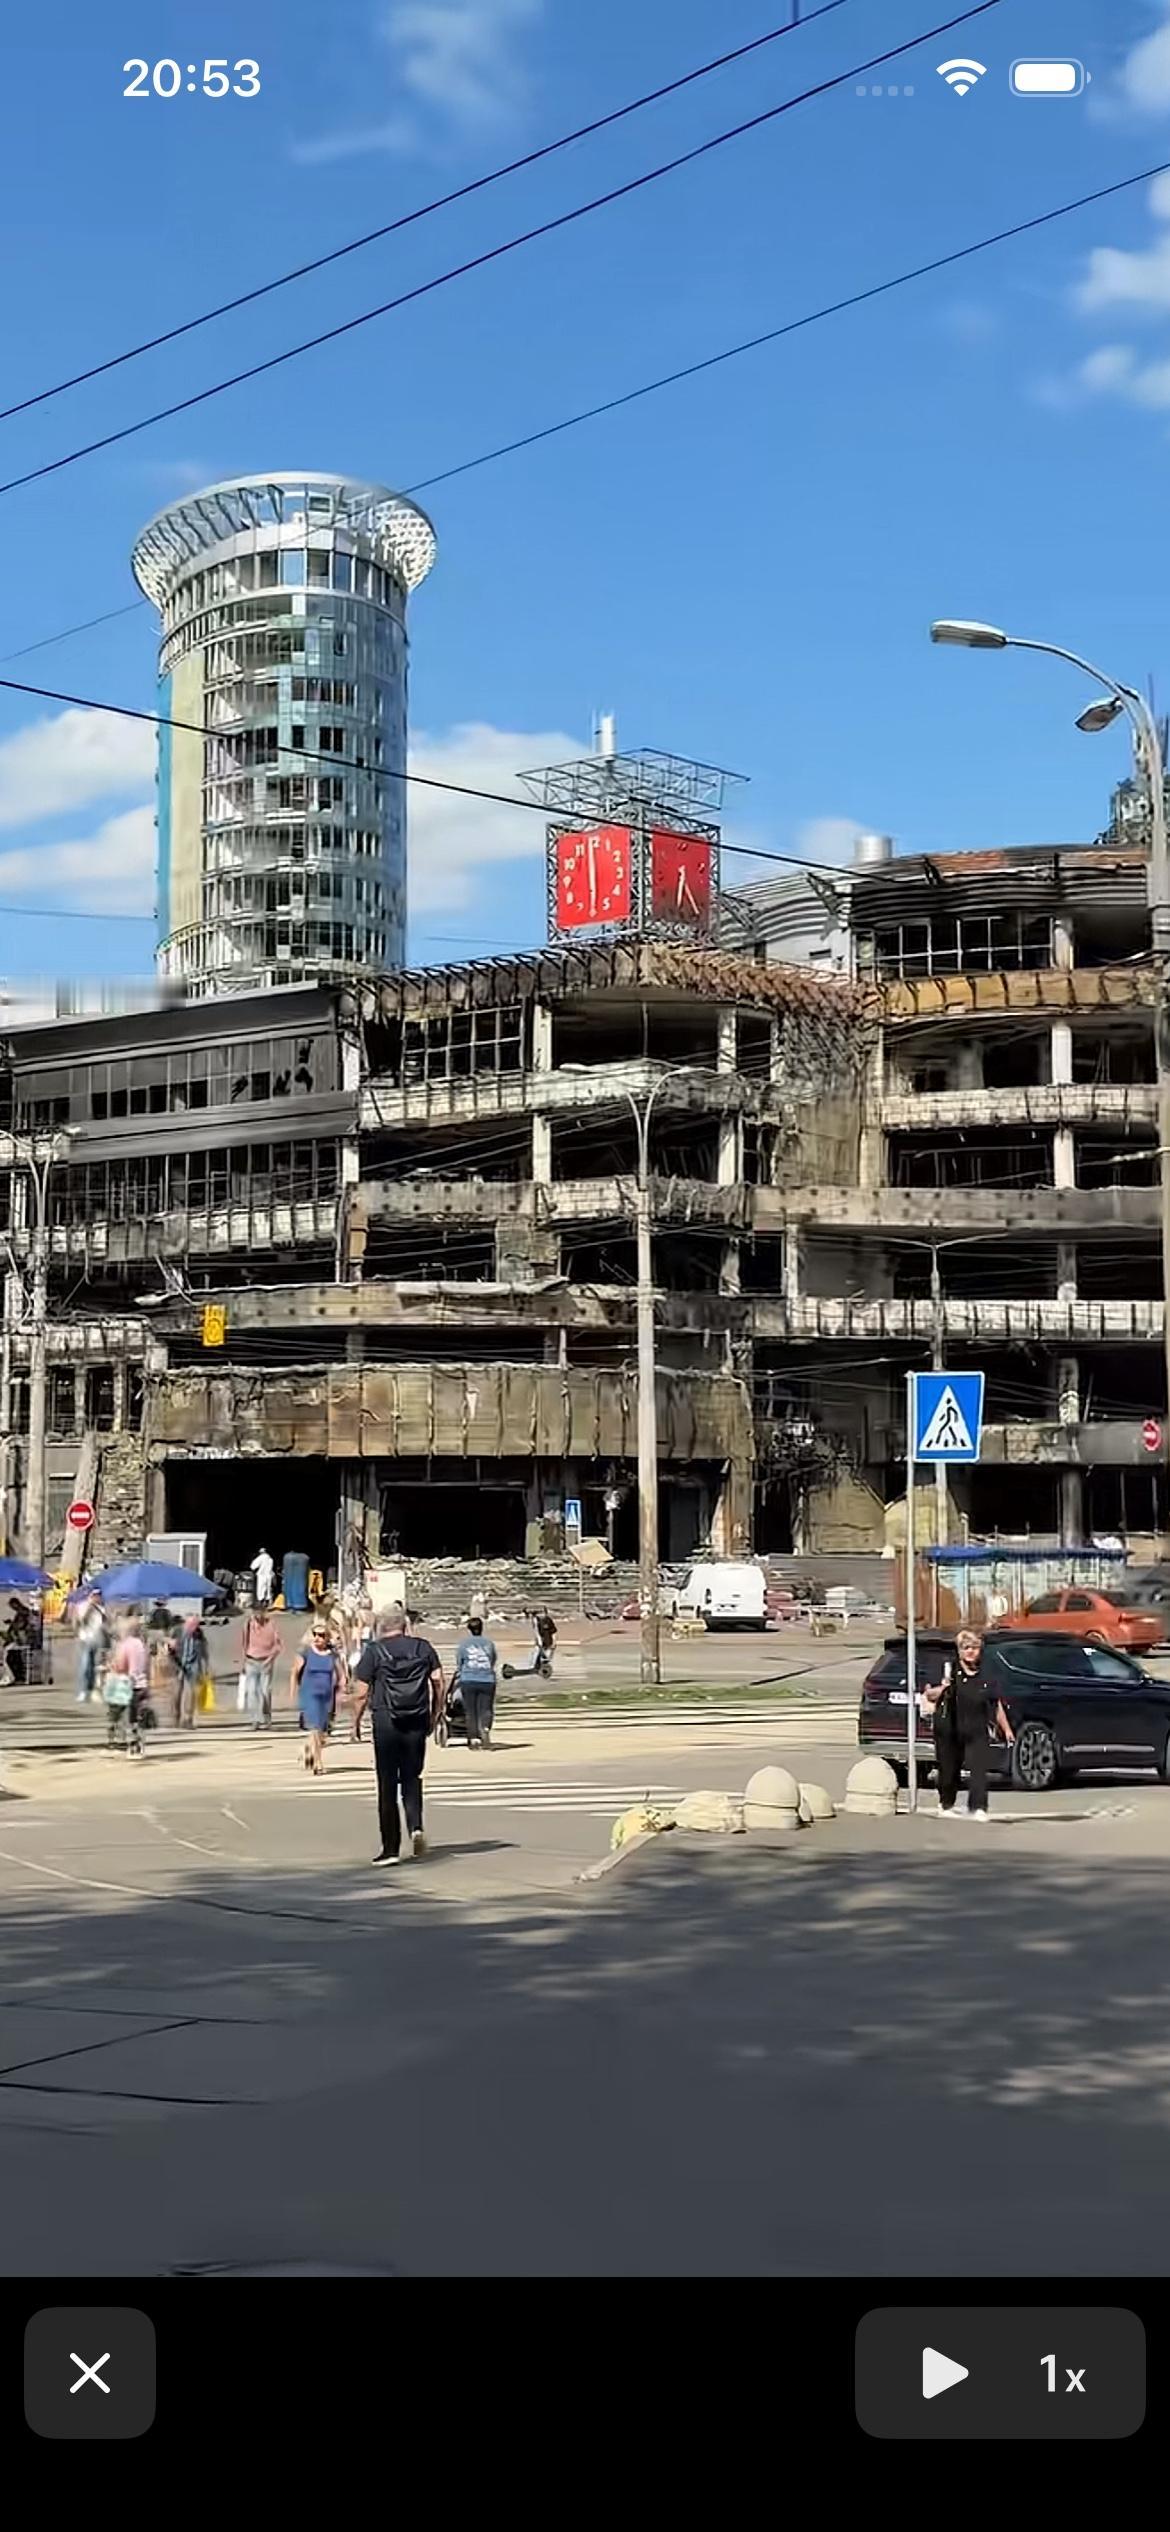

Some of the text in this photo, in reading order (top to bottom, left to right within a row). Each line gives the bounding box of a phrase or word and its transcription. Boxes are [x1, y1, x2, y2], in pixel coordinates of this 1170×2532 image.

[574, 843, 585, 857] 11
[613, 850, 621, 862] 2
[564, 857, 575, 870] 10
[603, 897, 611, 911] 5
